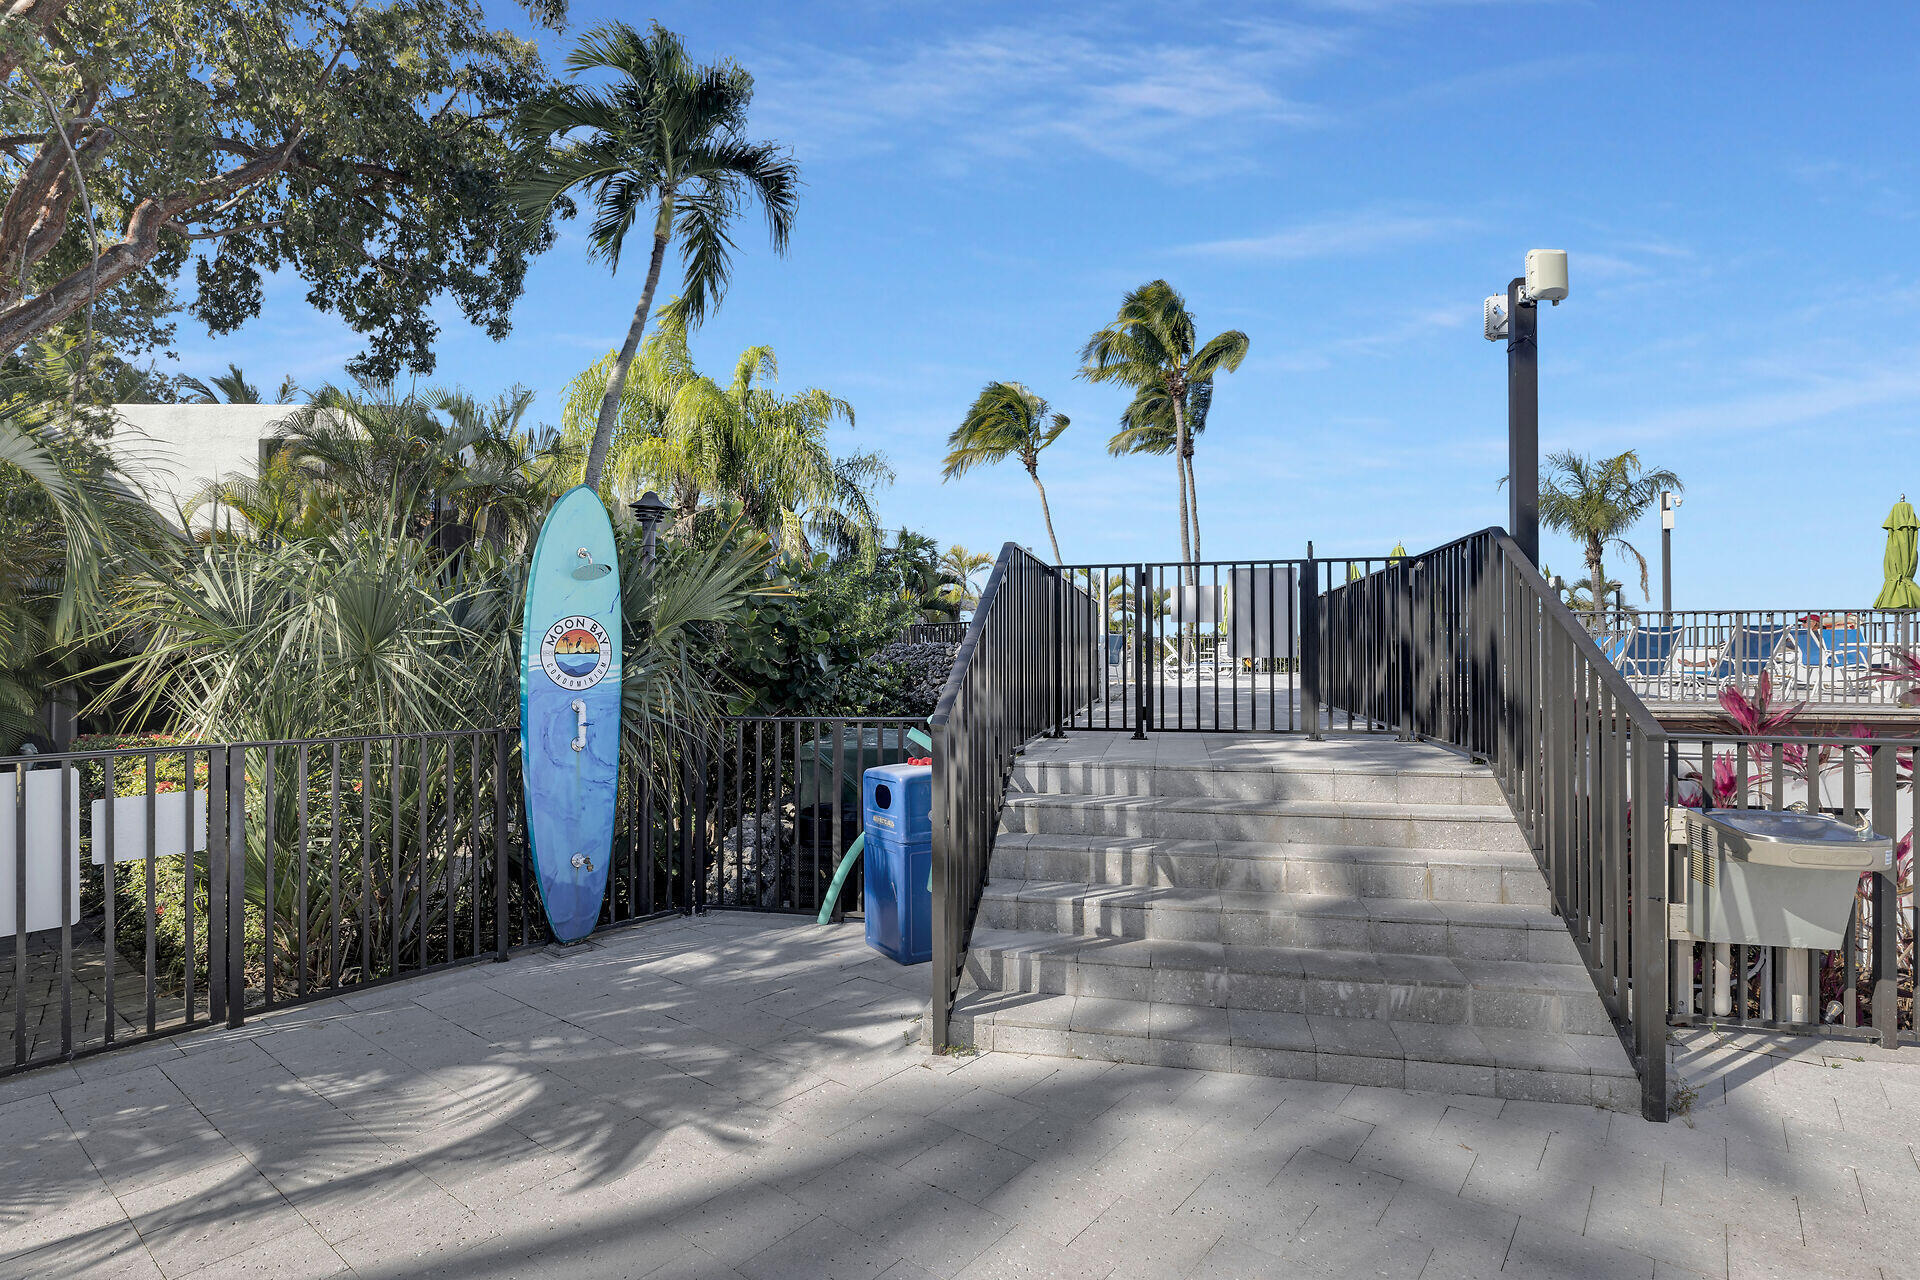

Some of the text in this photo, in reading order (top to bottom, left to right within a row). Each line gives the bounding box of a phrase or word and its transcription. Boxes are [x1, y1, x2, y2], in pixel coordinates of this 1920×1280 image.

[545, 618, 609, 647] MOON BAY
[546, 662, 607, 688] CONDOMINIUM
